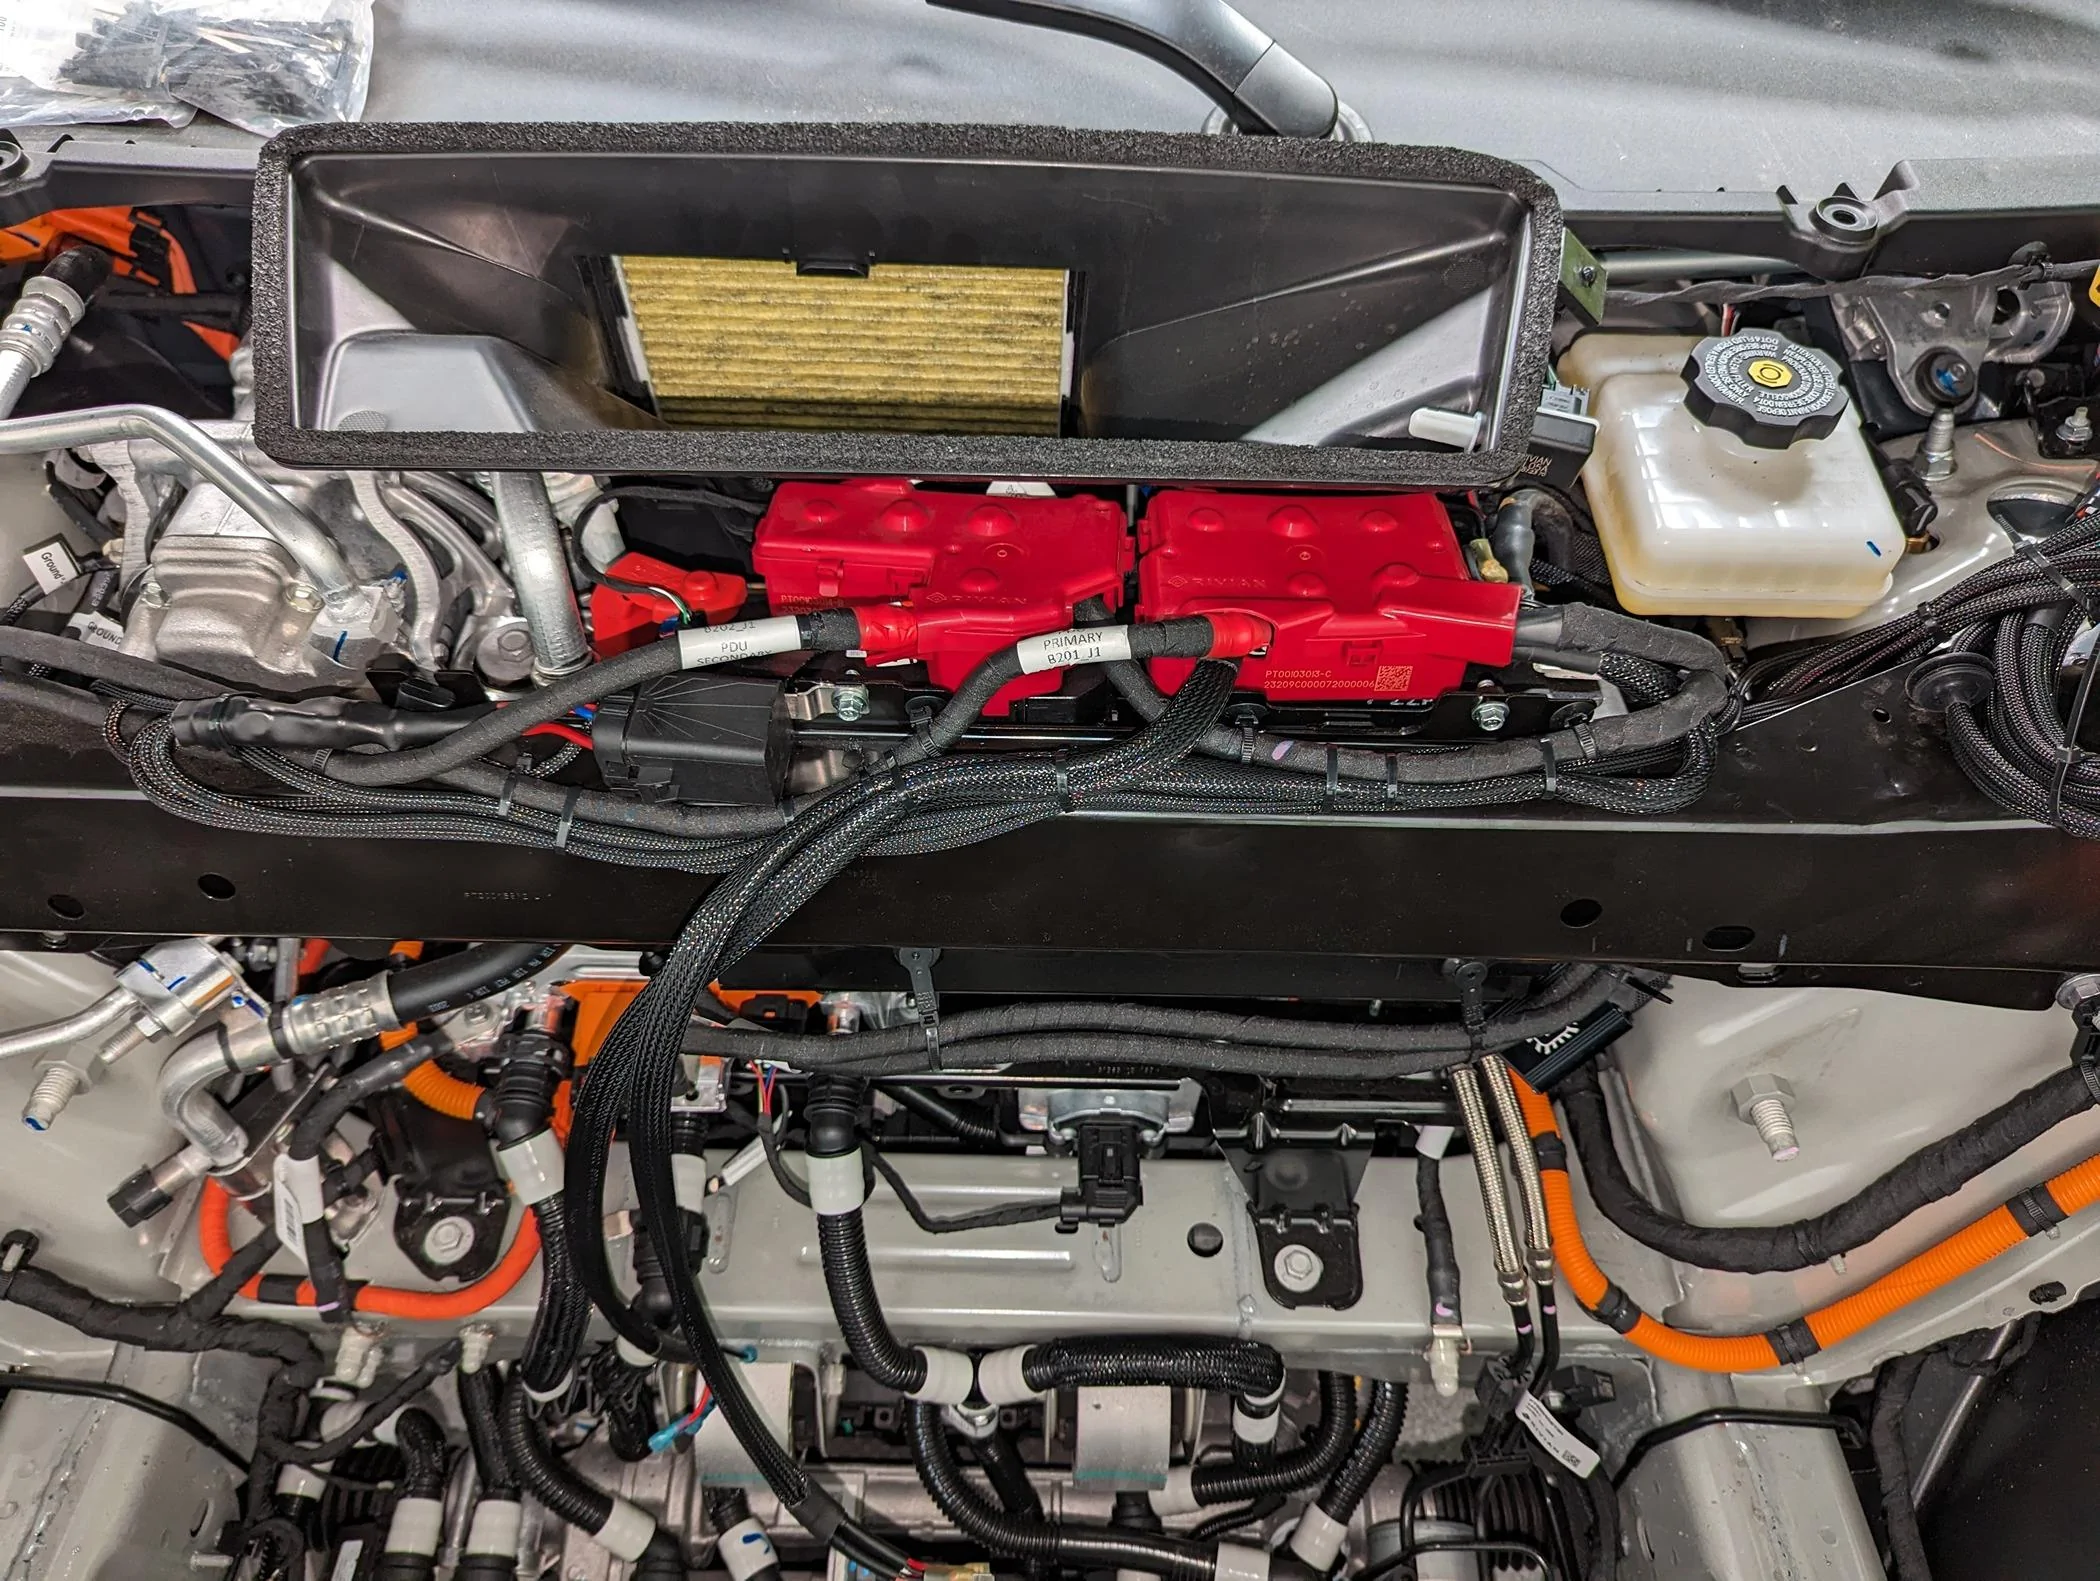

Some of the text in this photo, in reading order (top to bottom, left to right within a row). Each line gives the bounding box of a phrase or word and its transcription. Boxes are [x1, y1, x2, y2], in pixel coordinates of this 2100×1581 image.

[41, 552, 64, 580] Ground
[88, 621, 121, 645] GROUND
[1043, 631, 1103, 650] PRIMARY
[721, 640, 748, 653] PDU
[1047, 647, 1101, 665] B201_J1
[1265, 670, 1332, 678] PT00103013-C
